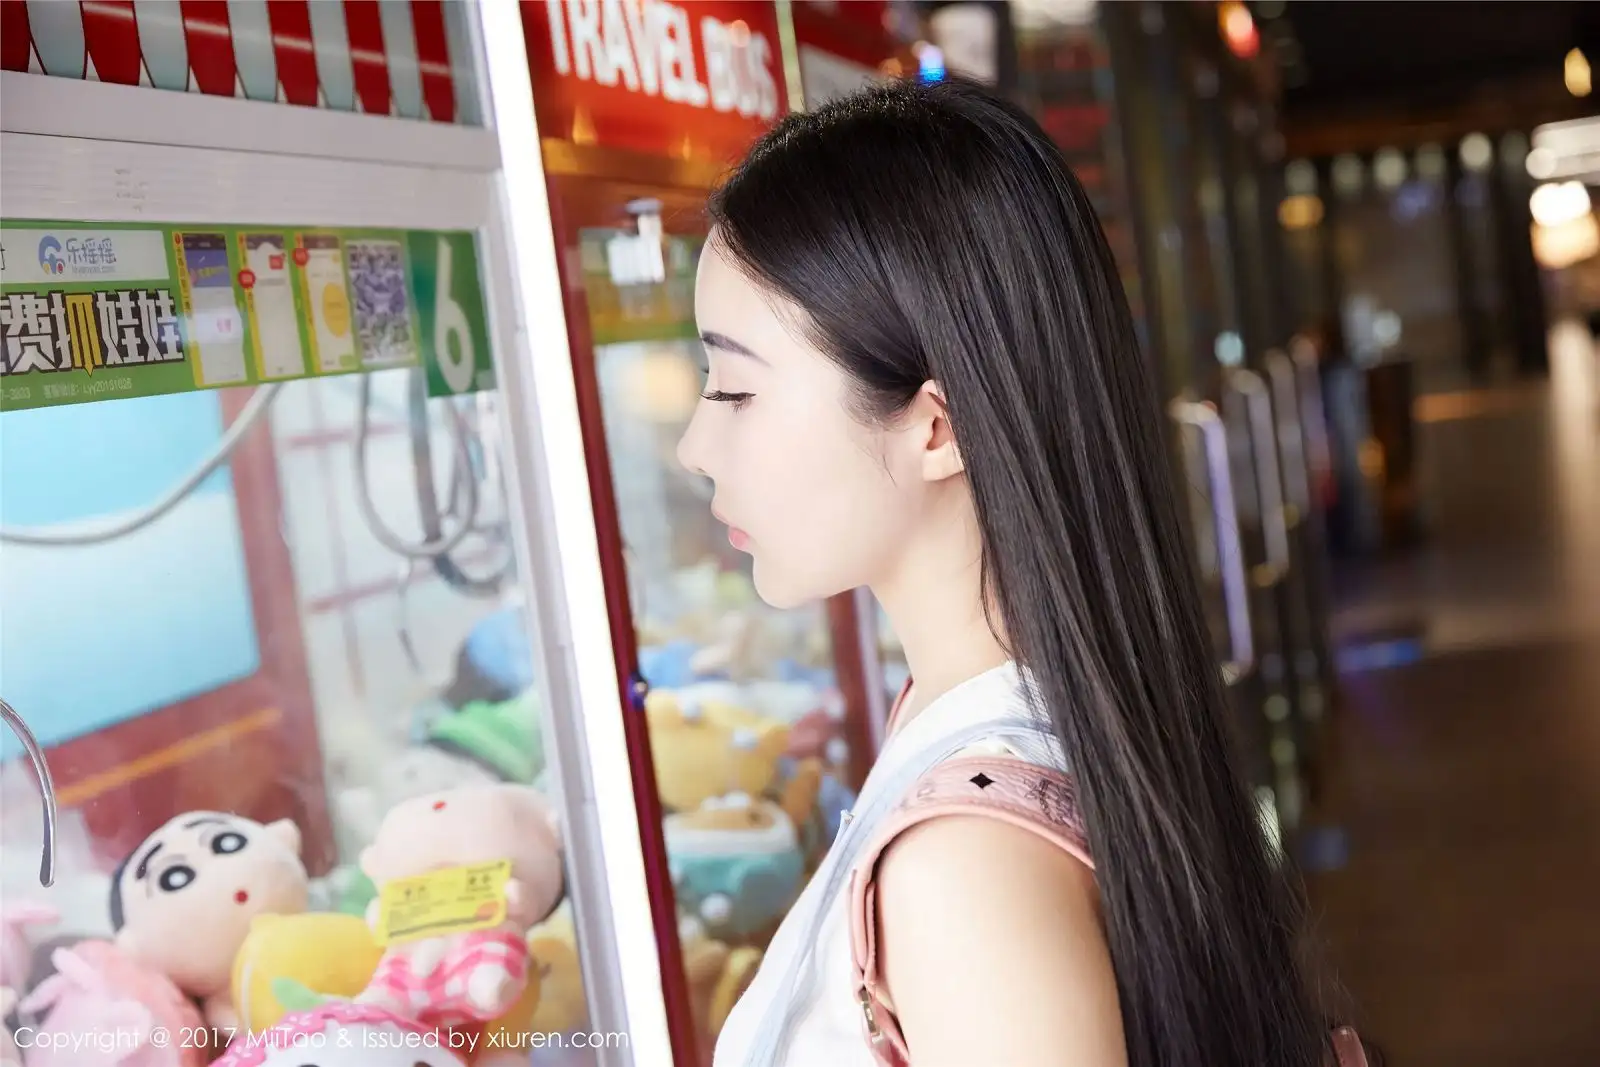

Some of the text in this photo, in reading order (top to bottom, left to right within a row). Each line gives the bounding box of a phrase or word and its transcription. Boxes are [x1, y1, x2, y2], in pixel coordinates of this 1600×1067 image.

[546, 0, 779, 120] TRAVEL BUS
[0, 289, 184, 377] 费抓娃娃
[434, 234, 475, 393] 6
